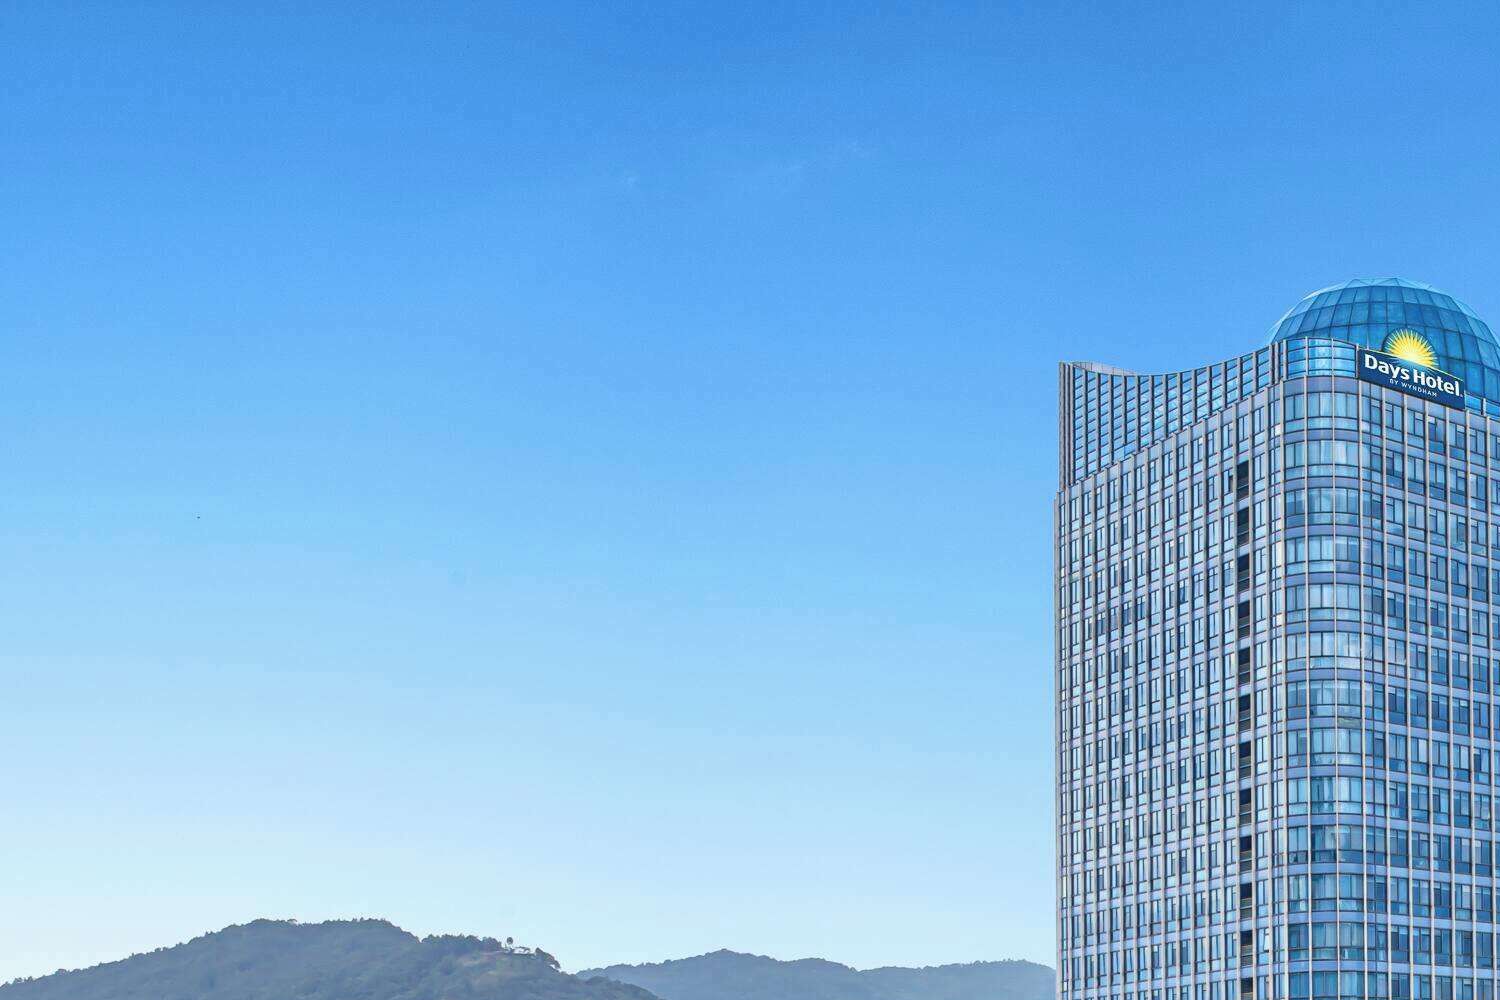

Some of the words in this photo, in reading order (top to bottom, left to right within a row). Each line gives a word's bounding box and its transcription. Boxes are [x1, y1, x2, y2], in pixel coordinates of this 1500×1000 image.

[1364, 353, 1410, 380] Days
[1413, 368, 1460, 397] Hotel
[1401, 382, 1438, 397] WYNDHAM
